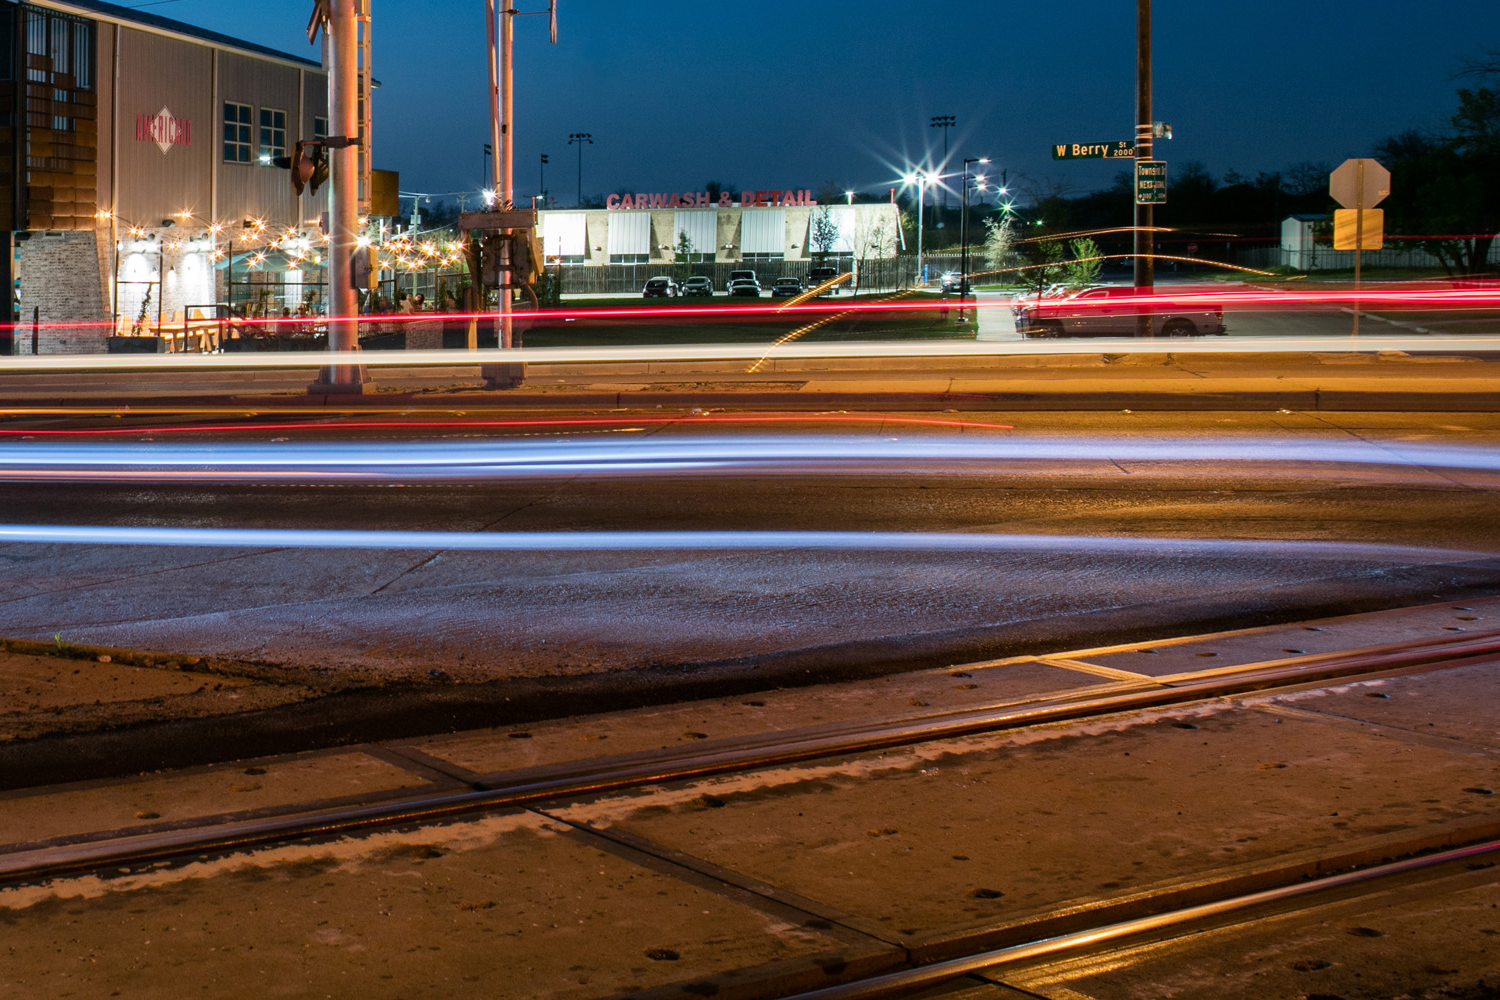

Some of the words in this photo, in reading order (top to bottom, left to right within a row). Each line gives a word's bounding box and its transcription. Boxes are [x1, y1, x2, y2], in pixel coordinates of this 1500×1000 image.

[135, 113, 192, 147] AMERICADO
[1056, 144, 1067, 157] W
[1072, 143, 1109, 158] Berry
[606, 191, 710, 210] CARWASH
[718, 191, 732, 208] &
[741, 189, 818, 207] DETAIL
